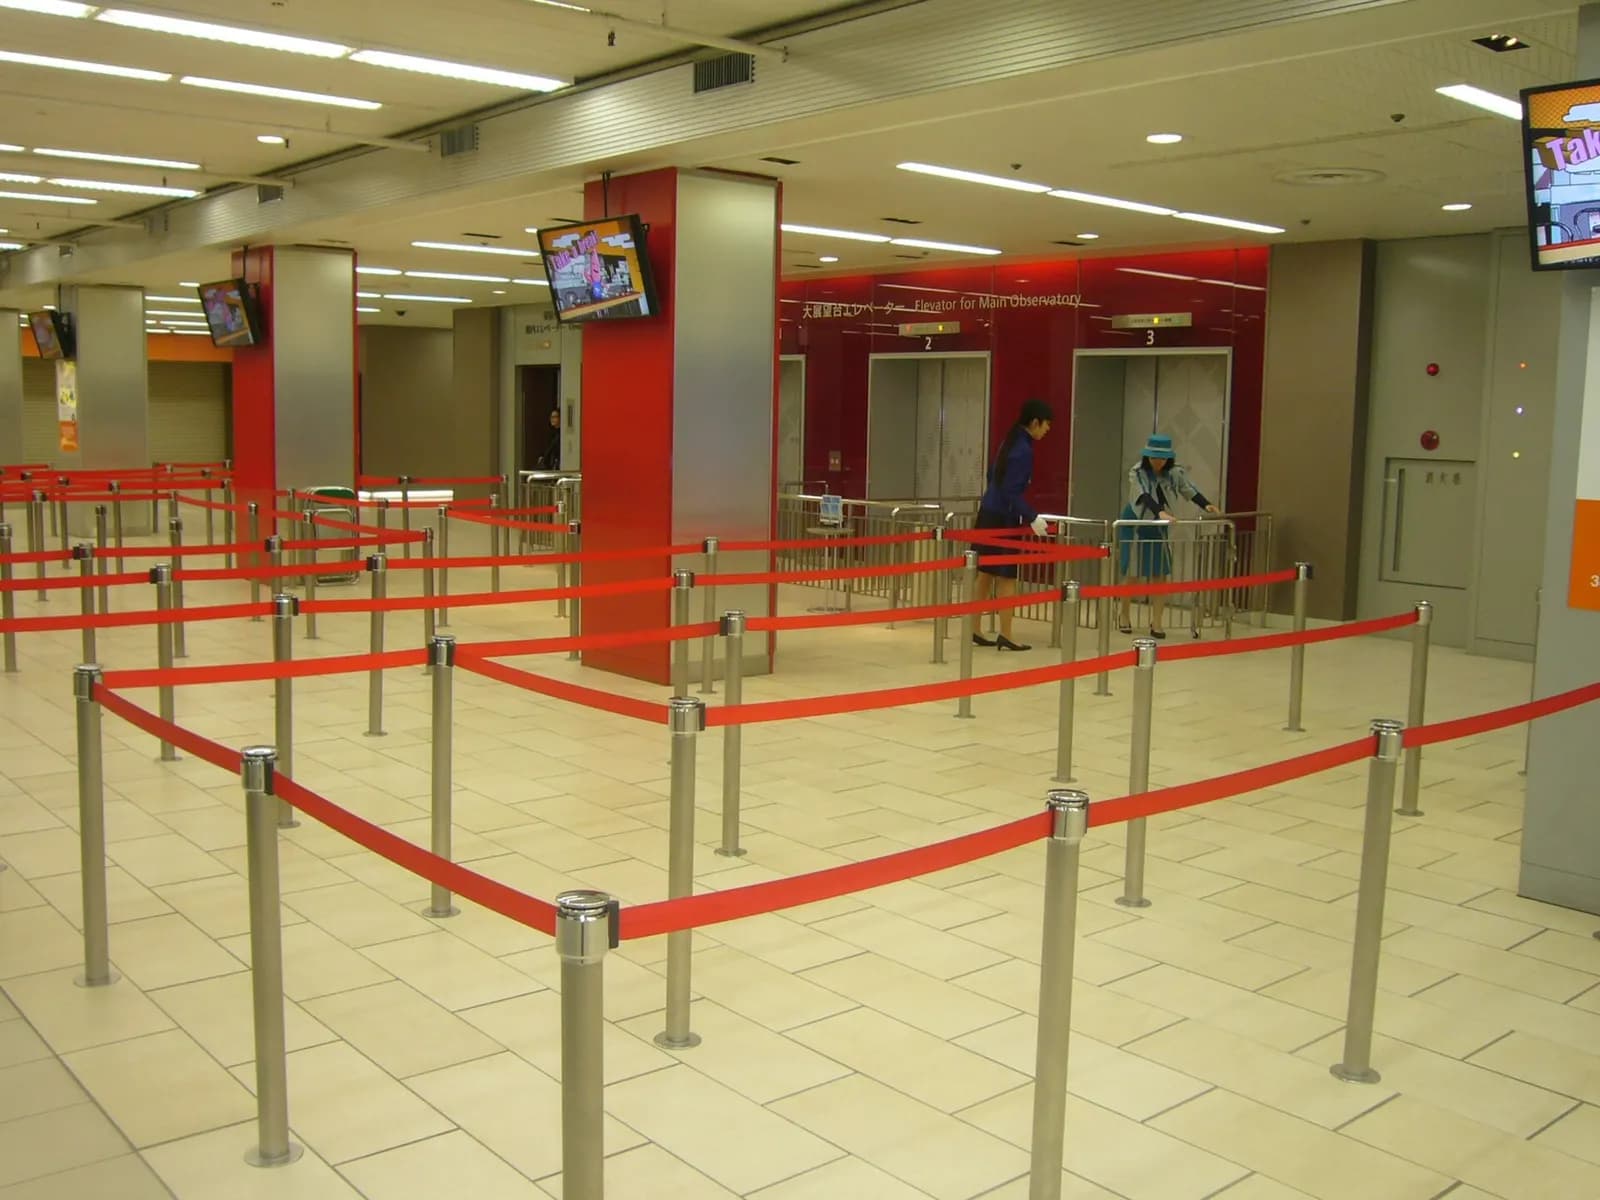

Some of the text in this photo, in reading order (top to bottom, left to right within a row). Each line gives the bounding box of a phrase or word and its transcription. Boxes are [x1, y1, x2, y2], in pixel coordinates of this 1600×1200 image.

[914, 293, 1082, 313] Elevator for Main Observatory
[924, 336, 932, 351] 2
[1146, 330, 1155, 345] 3
